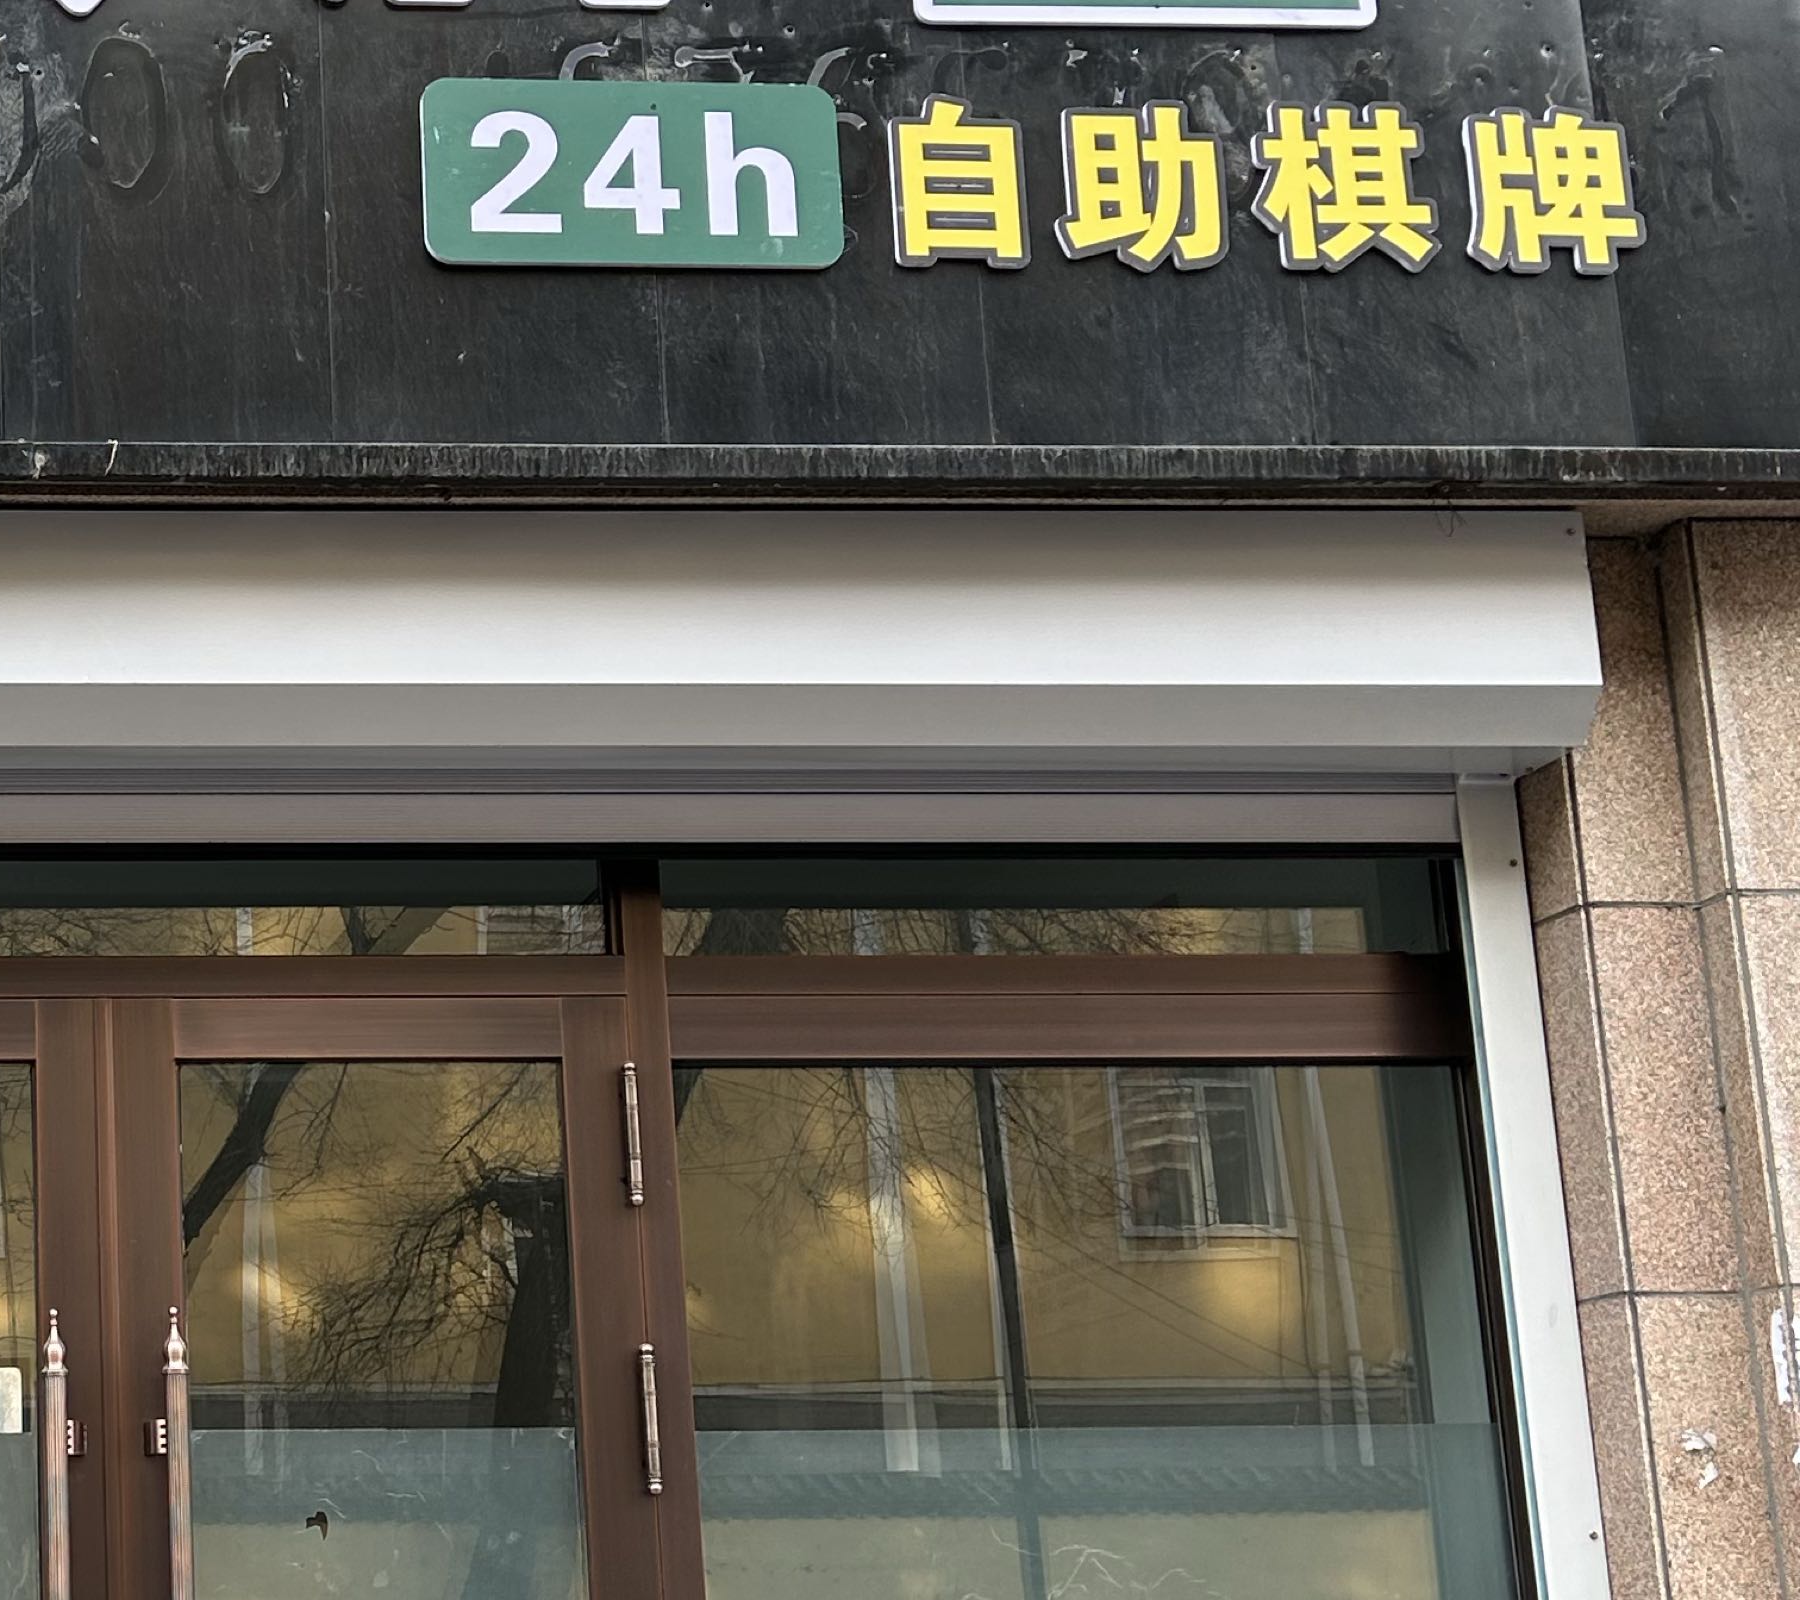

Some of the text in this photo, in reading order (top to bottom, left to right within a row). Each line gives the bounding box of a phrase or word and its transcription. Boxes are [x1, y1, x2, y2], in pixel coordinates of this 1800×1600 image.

[469, 92, 1646, 276] 24h 自助棋牌
